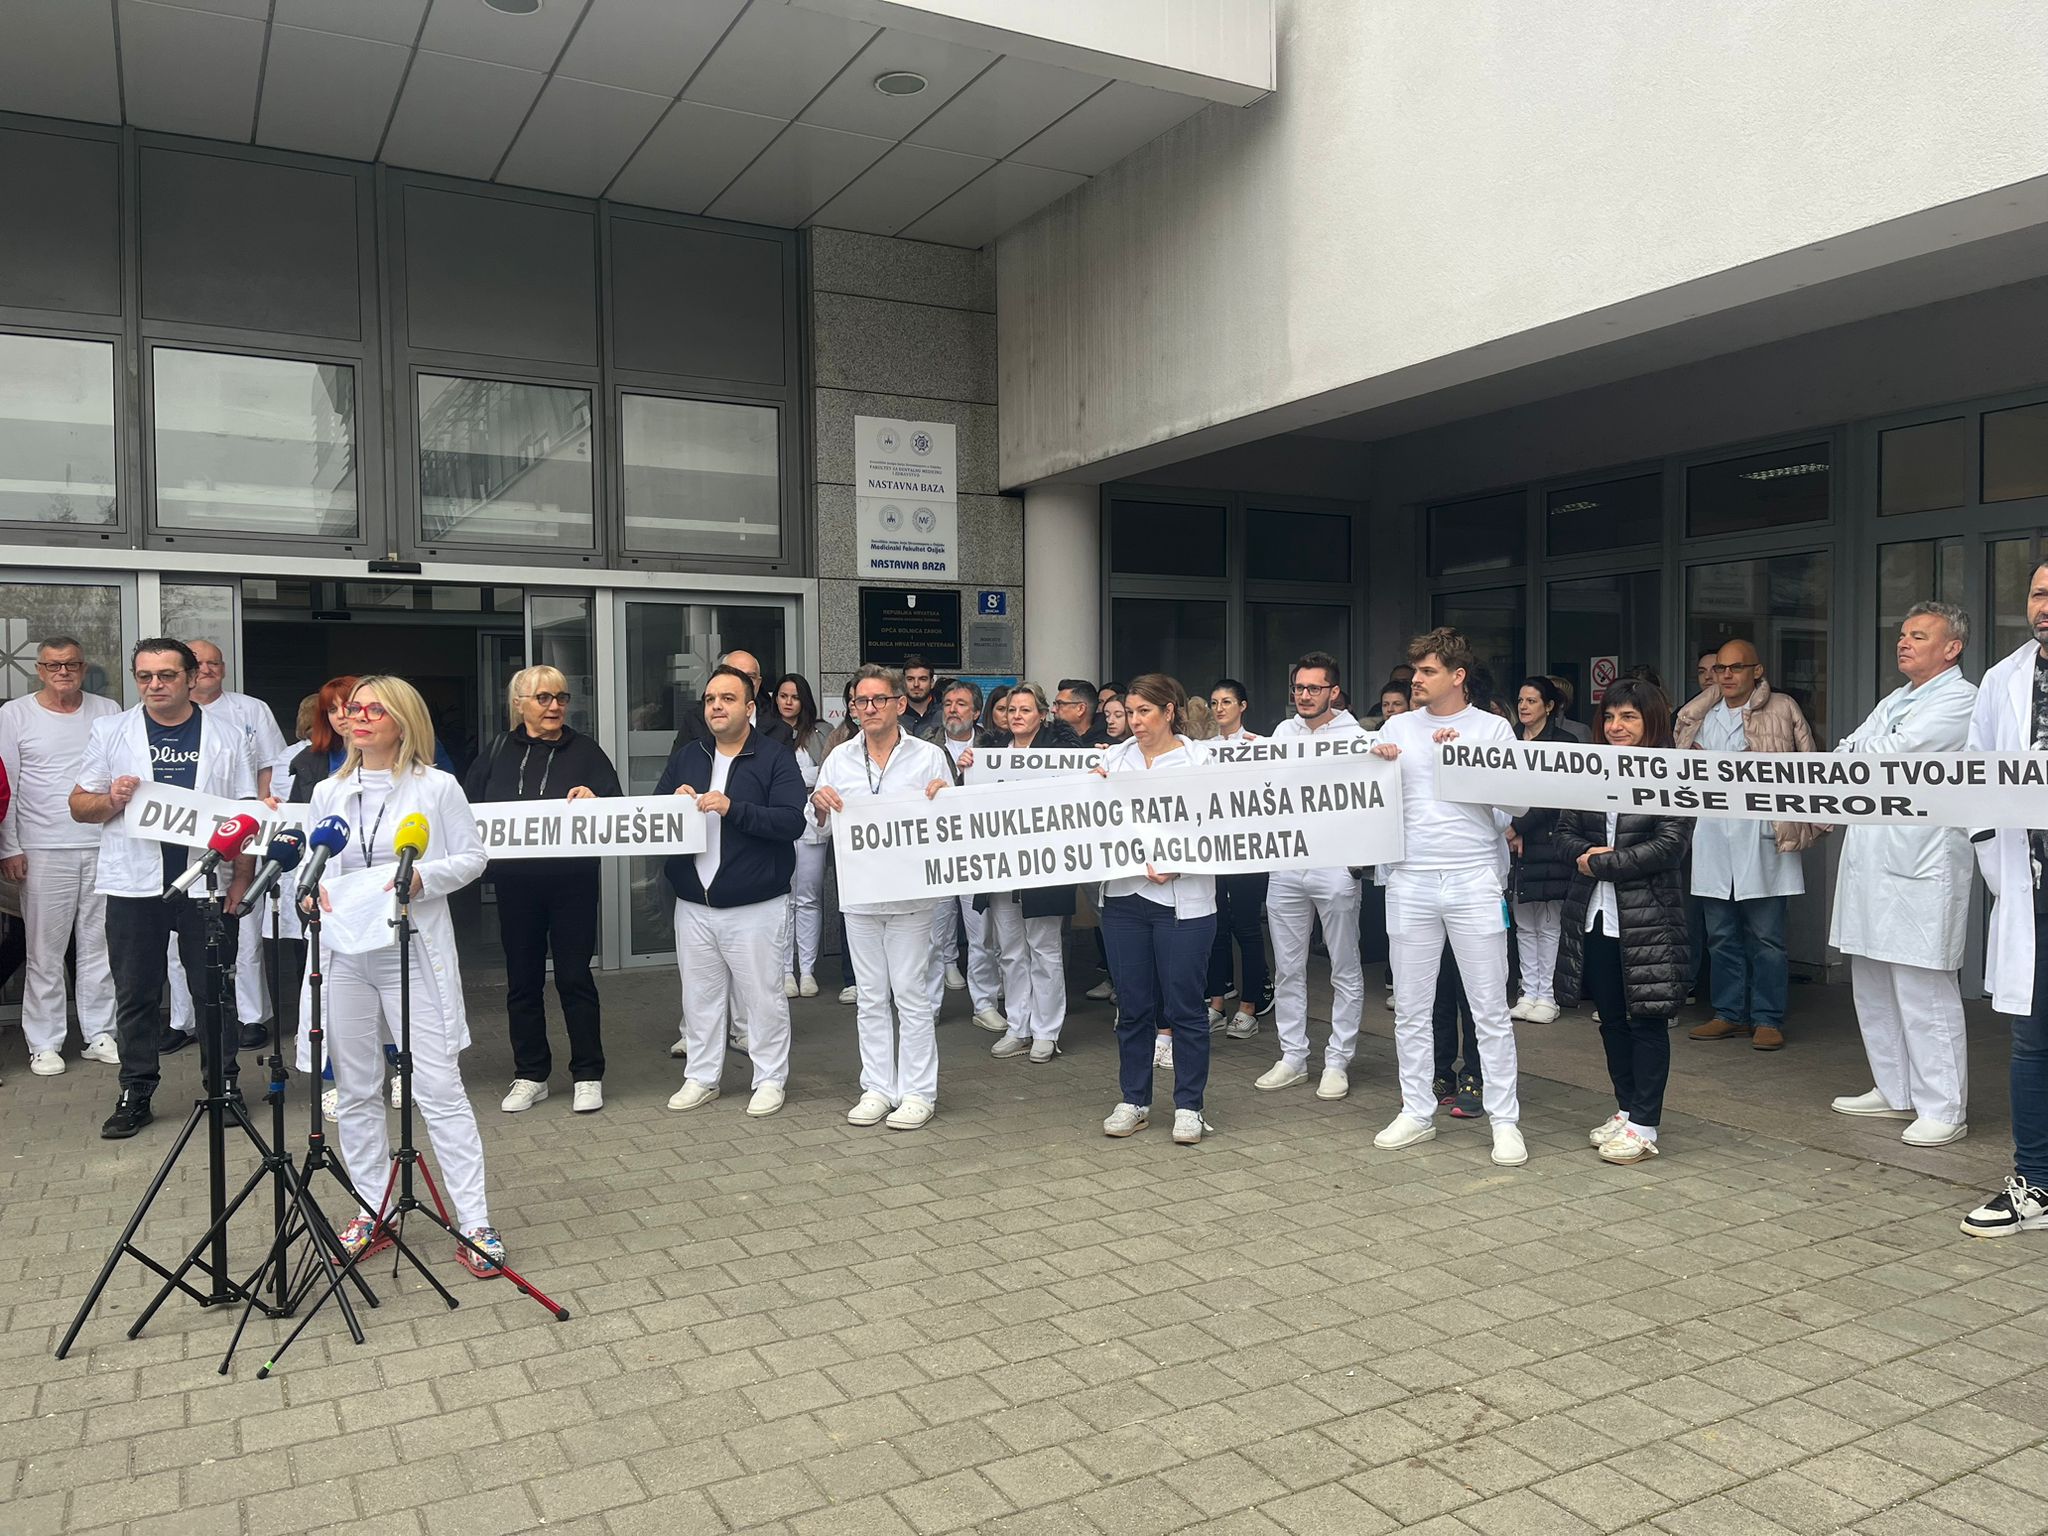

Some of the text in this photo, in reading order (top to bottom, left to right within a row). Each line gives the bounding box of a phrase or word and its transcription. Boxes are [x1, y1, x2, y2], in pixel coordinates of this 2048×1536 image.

[868, 479, 945, 493] NASTAVNA BAZA
[870, 559, 946, 571] NASTAVNA BAZA
[927, 546, 945, 554] Osijek
[986, 754, 1002, 770] U
[1298, 743, 1305, 758] I
[1315, 735, 1376, 756] PEČ
[1442, 745, 2048, 785] DRAGA VLADO, RTG JE SKENIRAO TVOJE NA
[850, 819, 930, 850] BOJITE
[936, 815, 963, 842] SE
[970, 800, 1123, 839] NUKLEARNOG
[1209, 793, 1224, 820] A
[1230, 782, 1294, 818] NAŠA
[1301, 780, 1385, 813] RADNA
[1631, 786, 1730, 811] PIŠE
[1744, 792, 1928, 817] ERROR.
[139, 800, 198, 837] DVA
[571, 807, 684, 845] RIJEŠEN
[925, 830, 1310, 885] MJESTA DIO SU TOG AGLOMERATA
